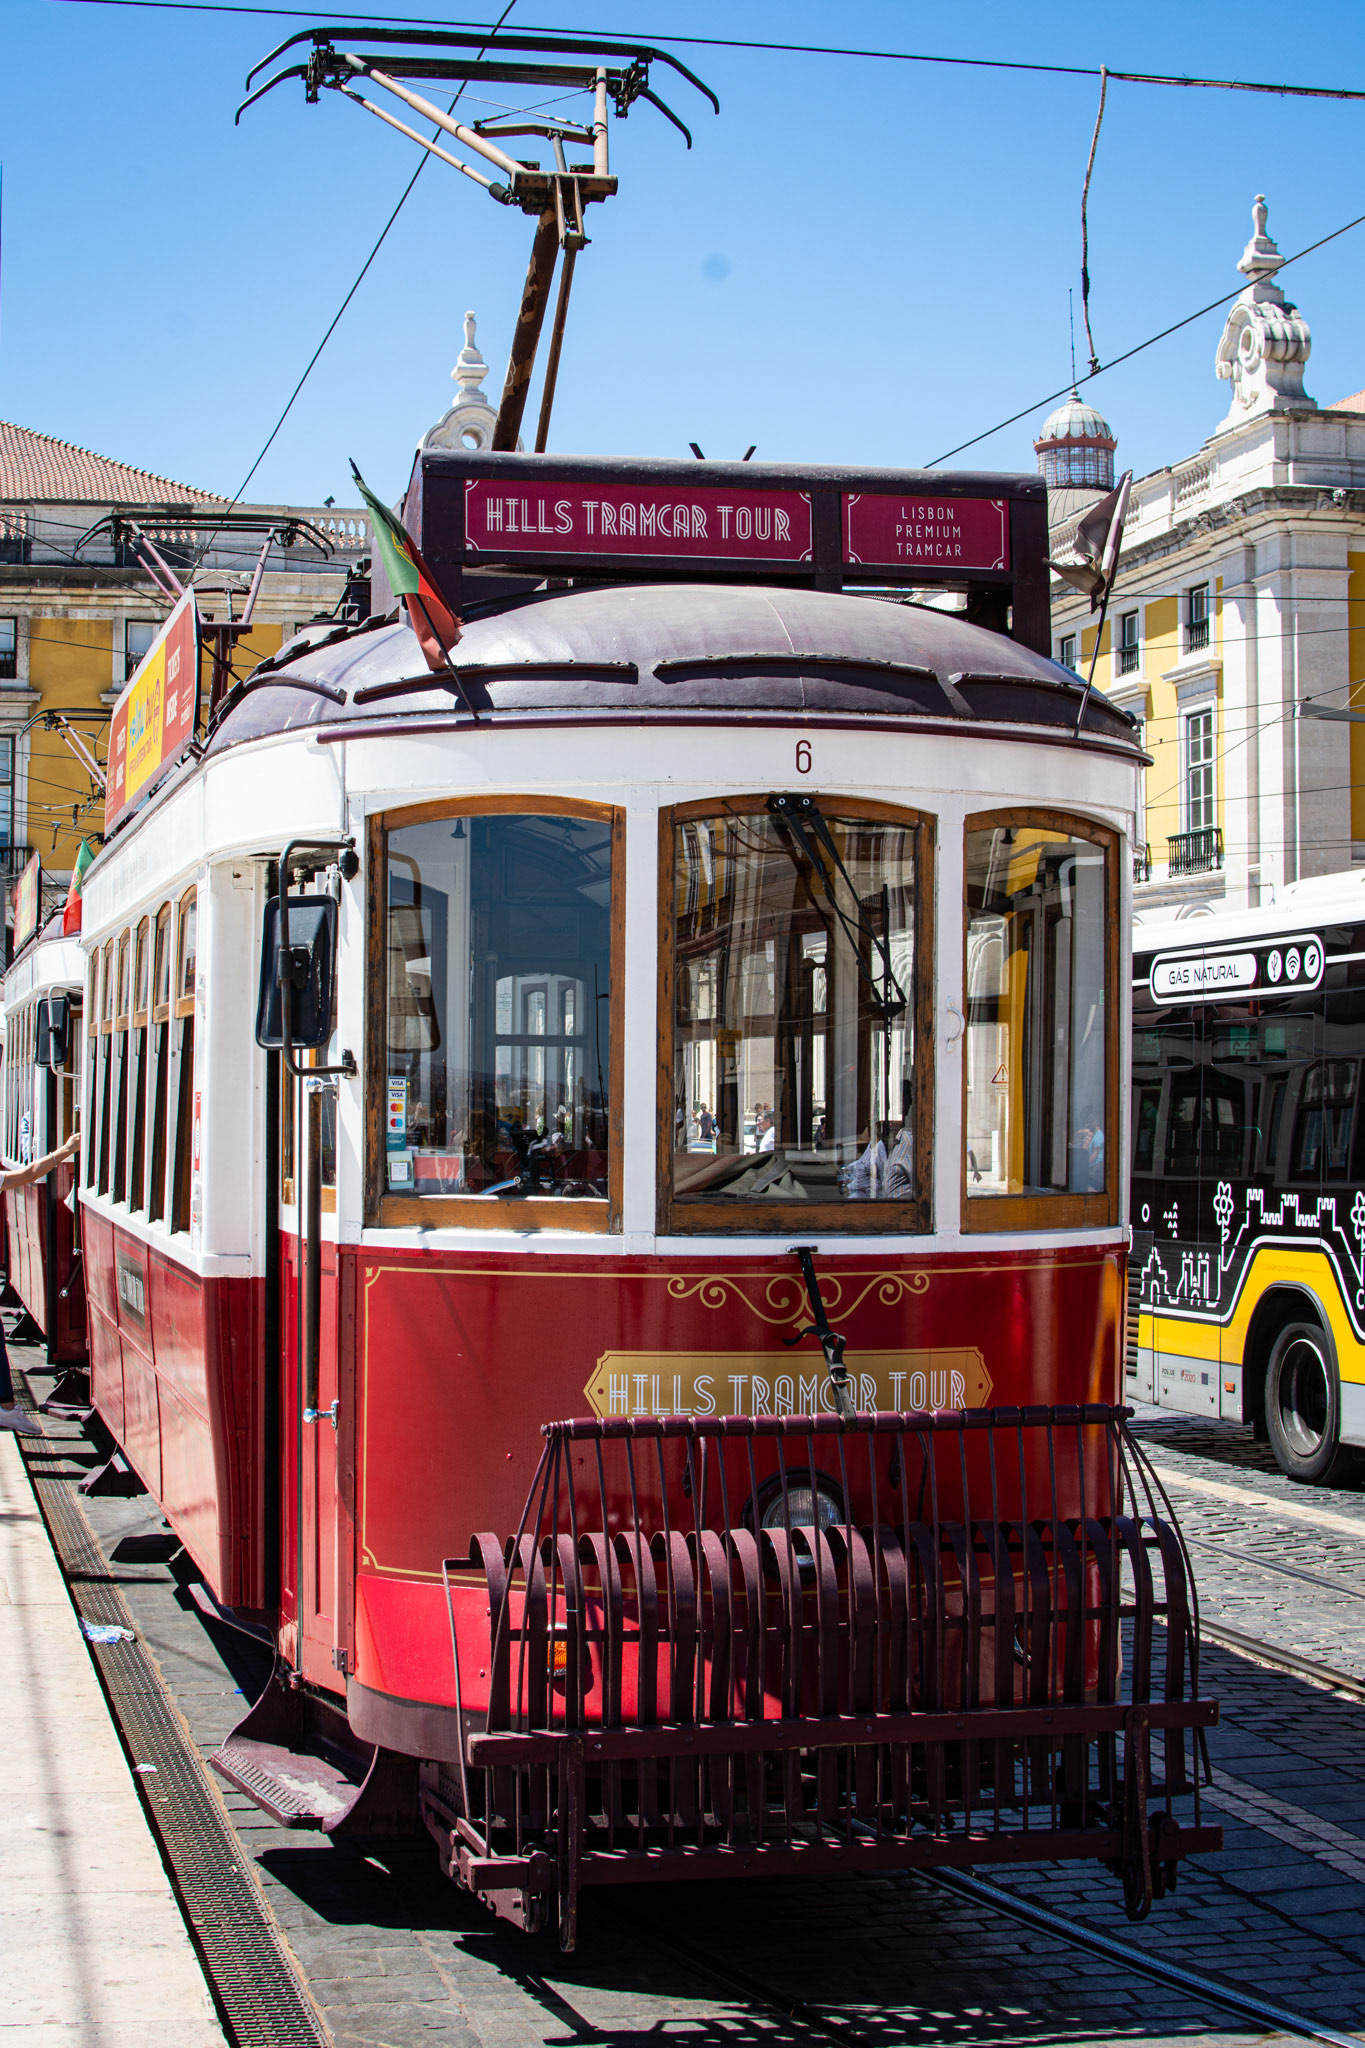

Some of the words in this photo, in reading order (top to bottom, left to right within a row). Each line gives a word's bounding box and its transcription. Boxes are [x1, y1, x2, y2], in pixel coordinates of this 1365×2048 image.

[486, 497, 574, 535] HILLS
[581, 500, 709, 539] TRAMCAR
[716, 505, 792, 542] TOUR
[901, 506, 954, 520] LISBON
[895, 524, 961, 538] PREMIUM
[896, 542, 962, 557] TRAMCAR
[795, 739, 812, 774] 6
[1168, 967, 1190, 985] GÁS
[1193, 963, 1240, 982] NATURAL
[608, 1373, 717, 1416] HILLS
[888, 1369, 967, 1412] TOUR
